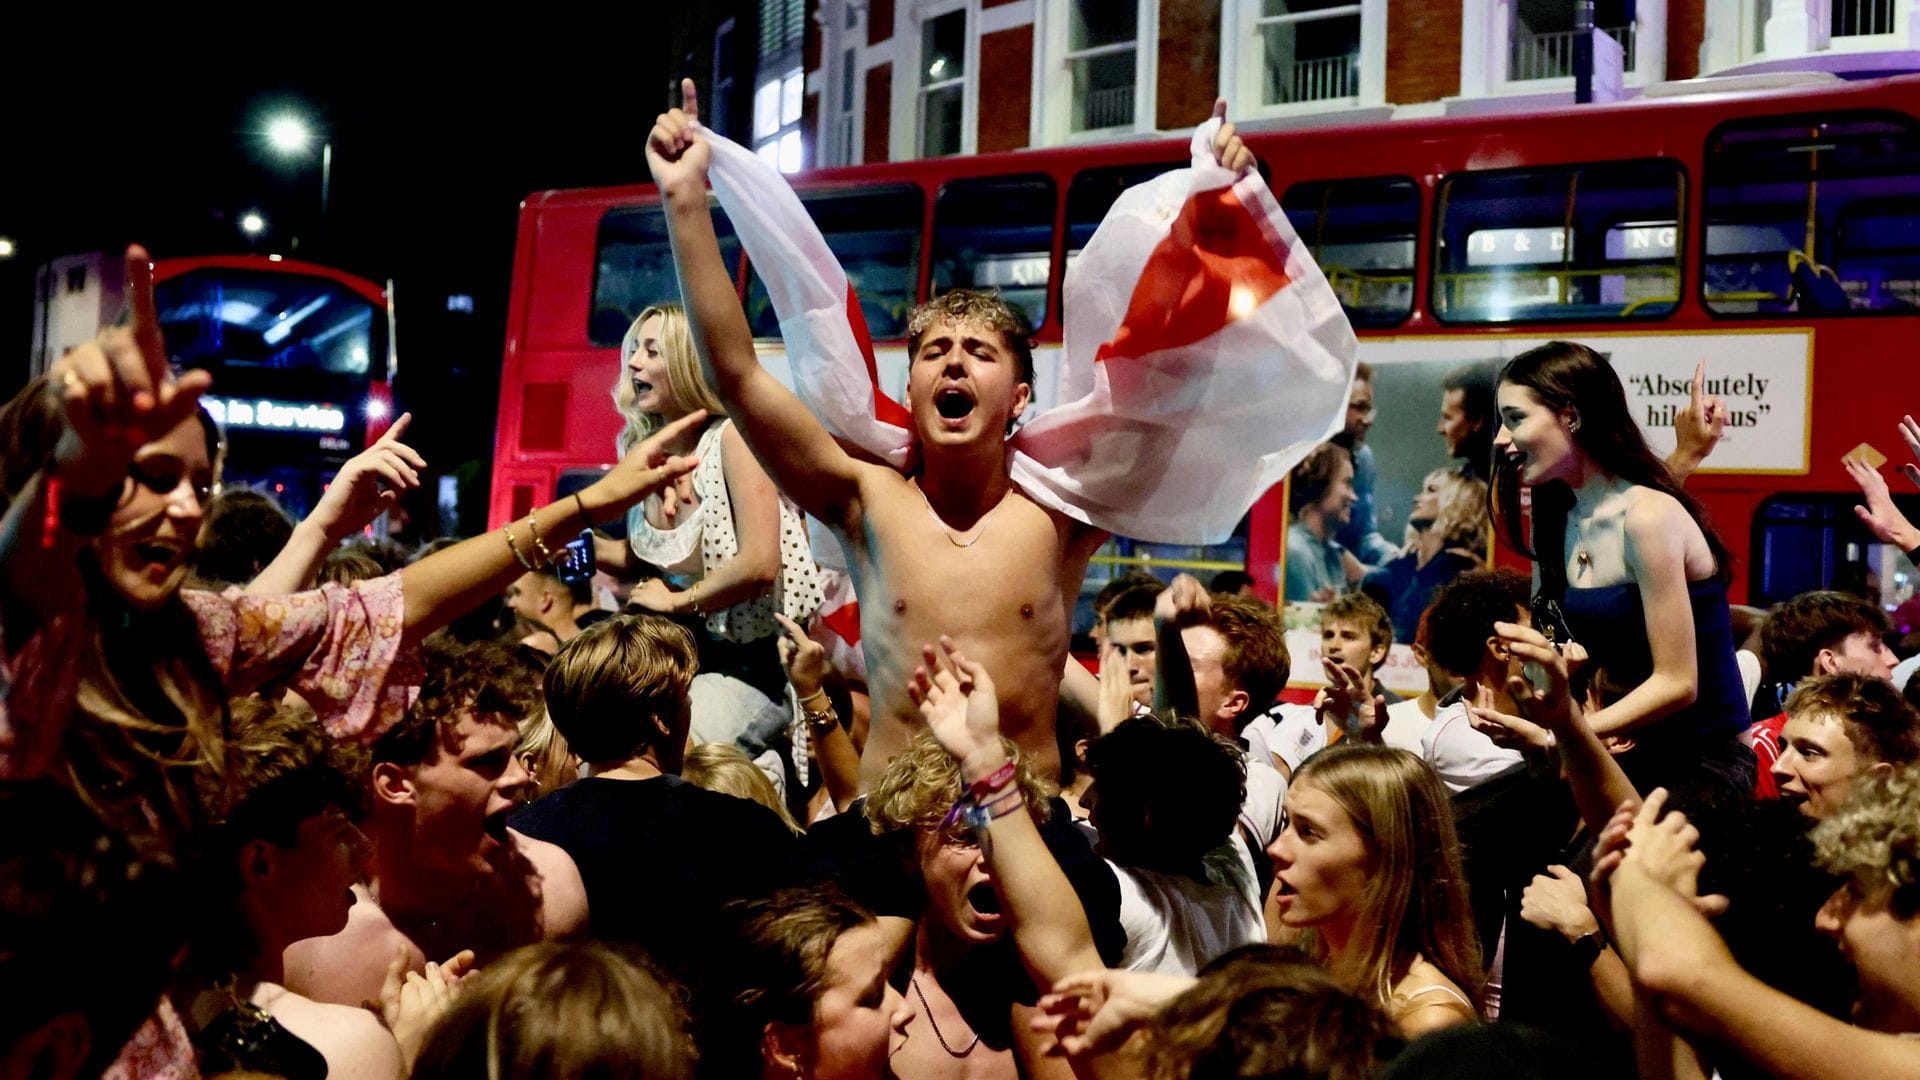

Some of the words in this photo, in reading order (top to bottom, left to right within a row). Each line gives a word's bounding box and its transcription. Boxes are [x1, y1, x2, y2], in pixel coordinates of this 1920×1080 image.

[1513, 231, 1531, 252] &
[1629, 373, 1769, 400] “Absoutely
[228, 400, 254, 424] in
[256, 401, 344, 430] Service
[1647, 404, 1771, 427] hilus”
